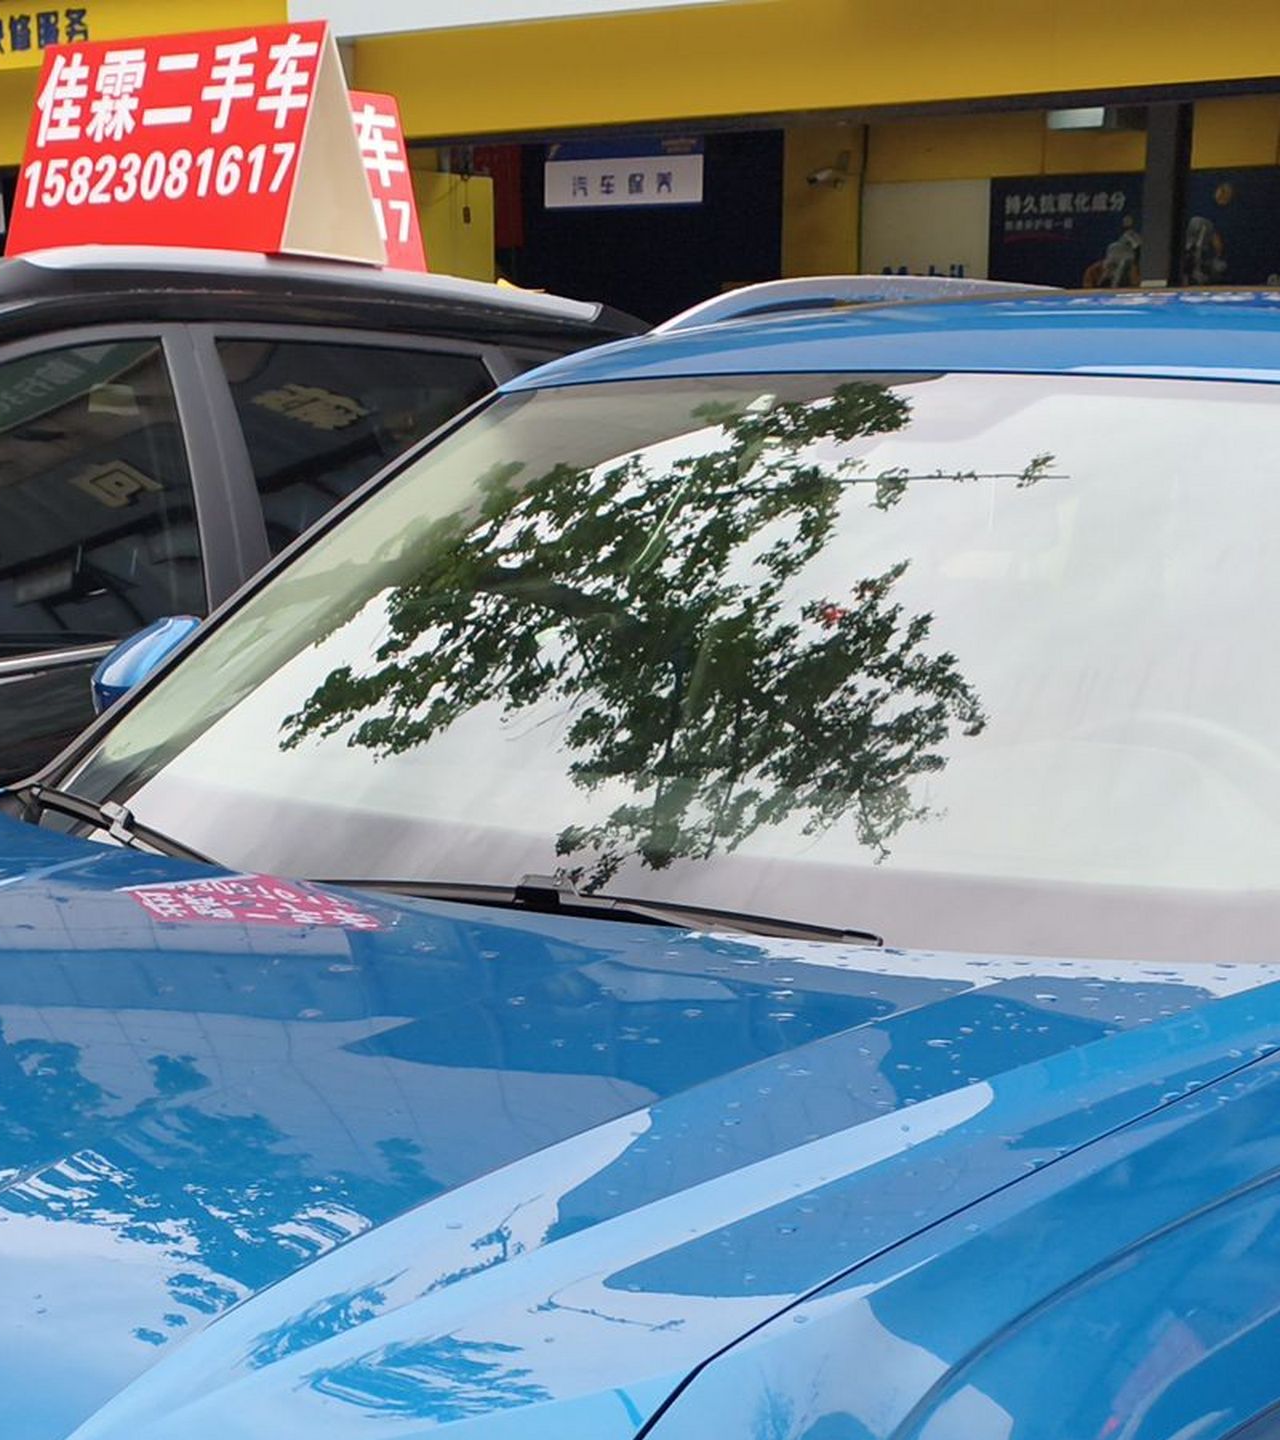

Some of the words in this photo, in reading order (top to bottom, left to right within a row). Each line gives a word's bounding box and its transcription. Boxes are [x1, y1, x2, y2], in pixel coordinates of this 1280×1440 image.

[36, 38, 319, 148] 佳霖二手车
[22, 141, 296, 209] 15823081617
